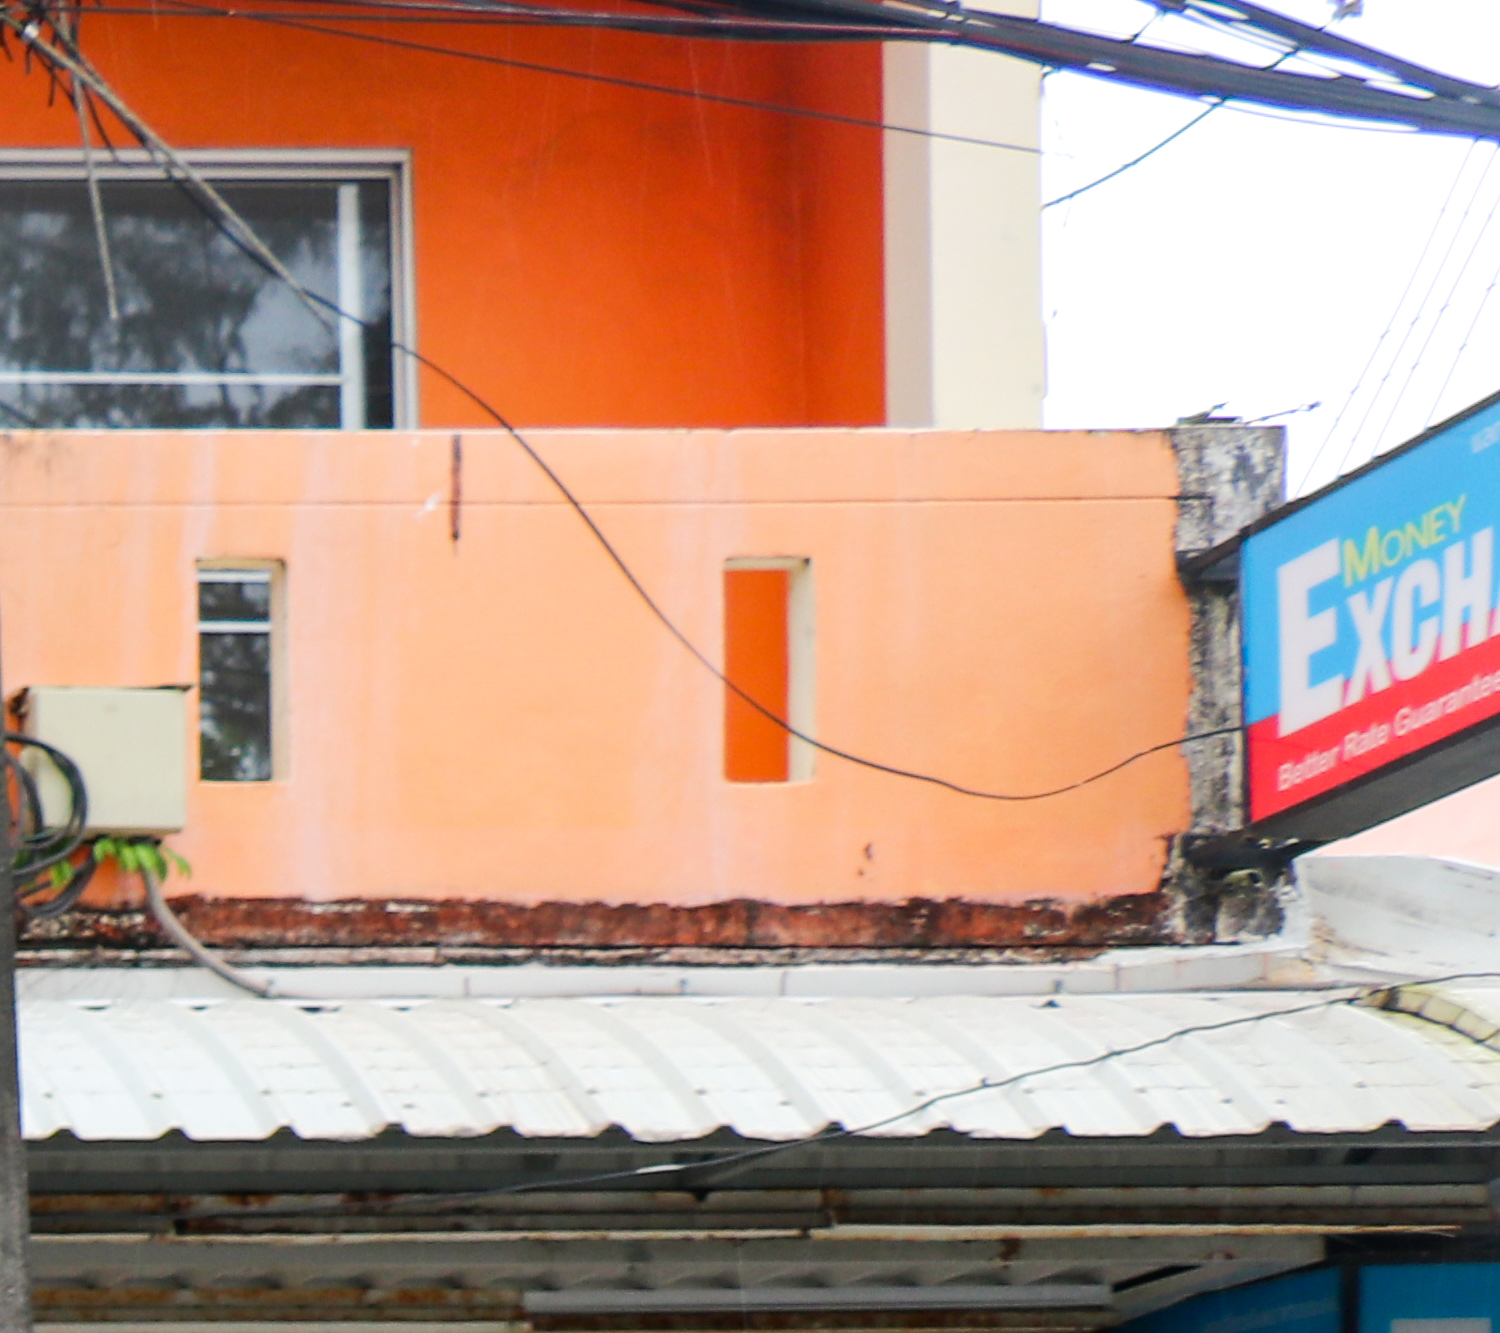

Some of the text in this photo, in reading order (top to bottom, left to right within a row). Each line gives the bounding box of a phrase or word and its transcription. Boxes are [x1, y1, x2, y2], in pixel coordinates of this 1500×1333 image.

[1277, 524, 1500, 738] EXCH
[1277, 744, 1339, 792] Better
[1343, 720, 1389, 763] Rate
